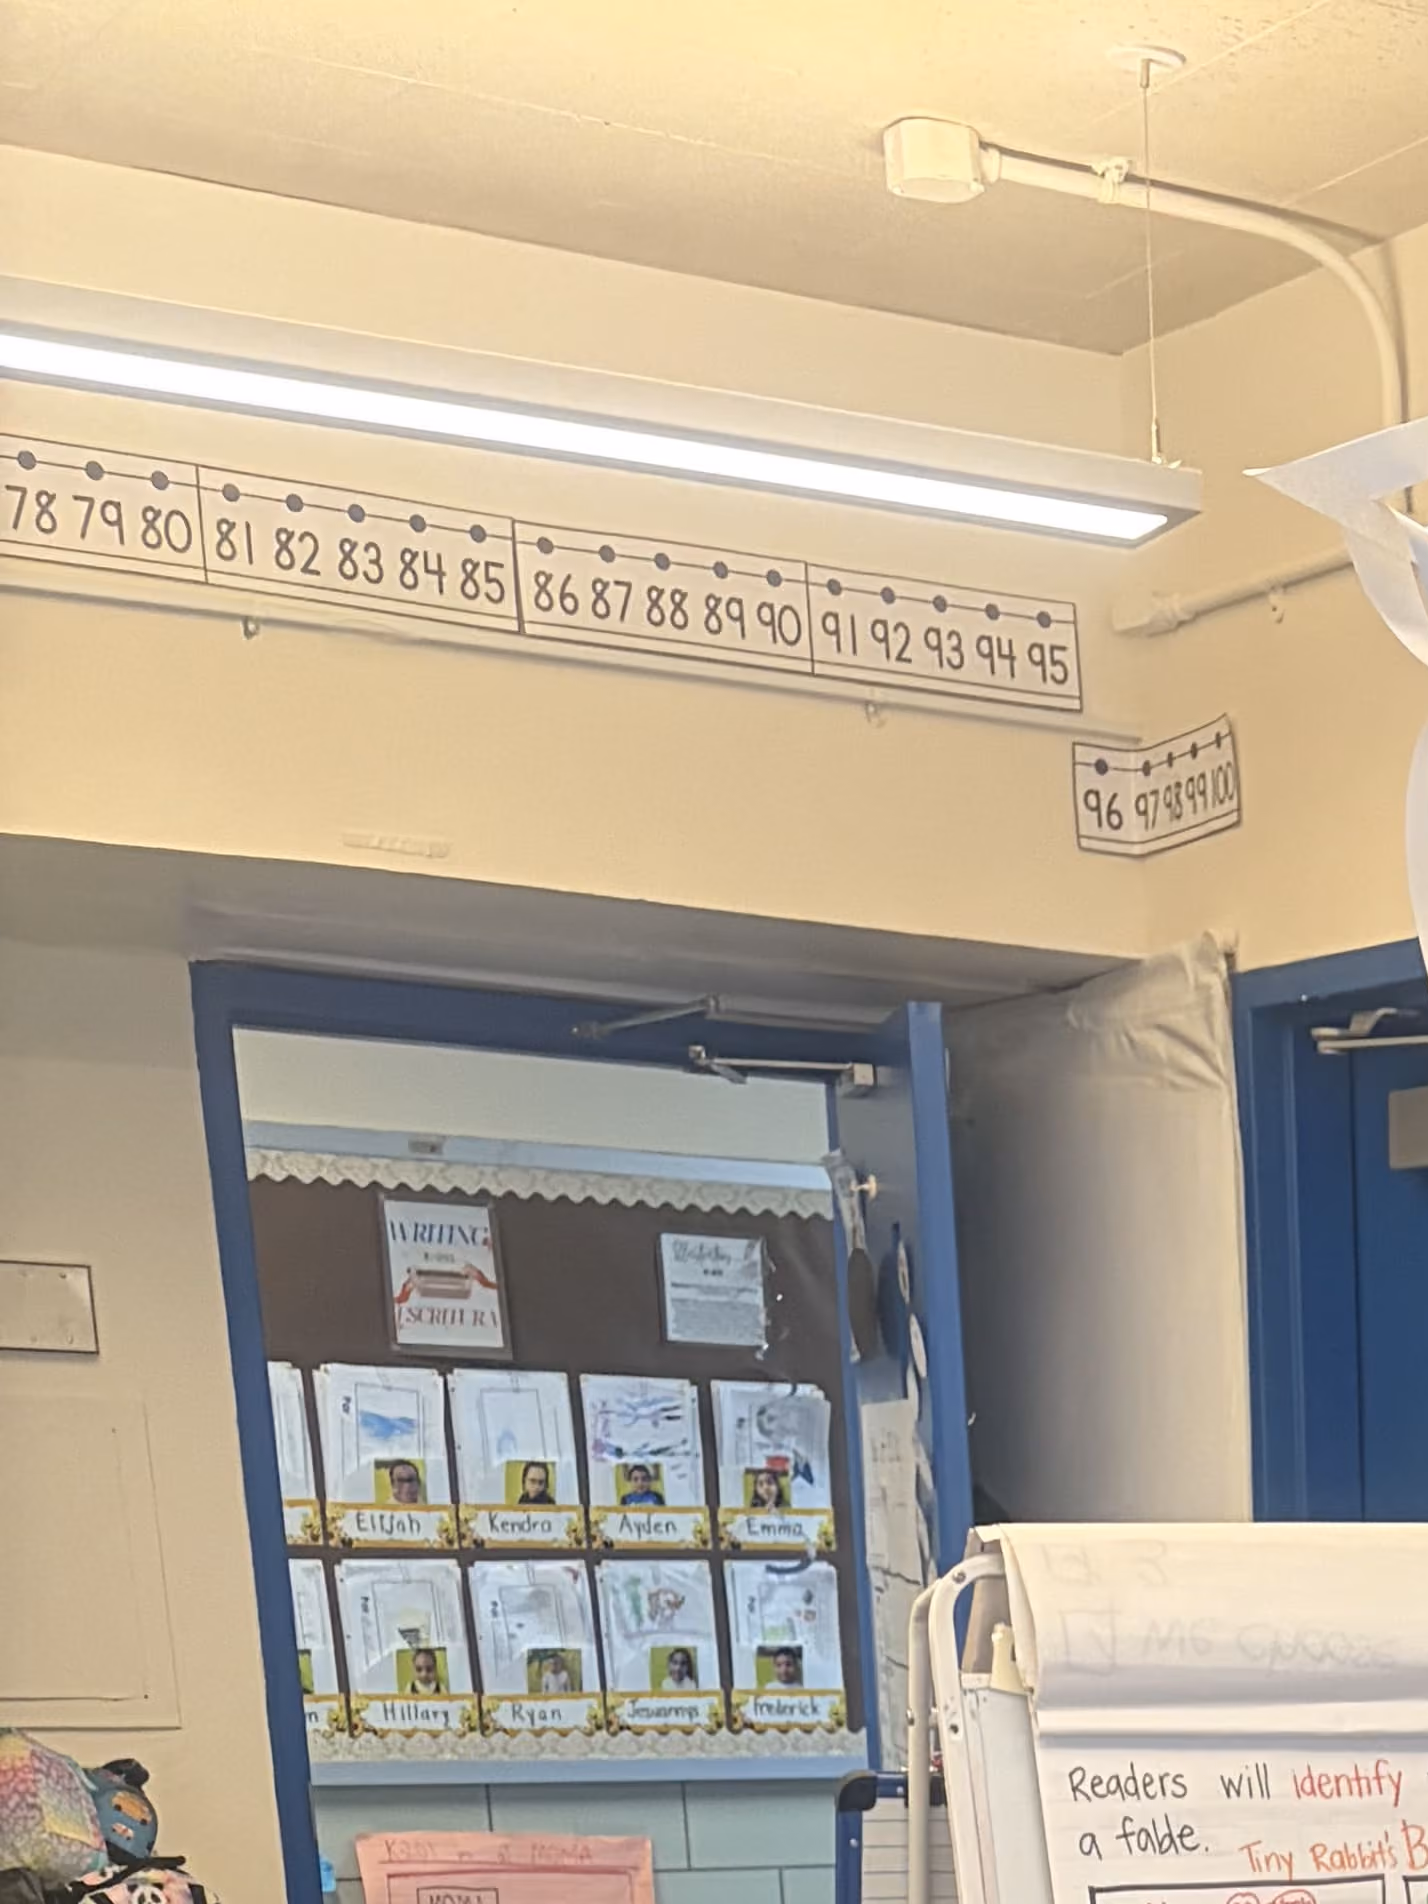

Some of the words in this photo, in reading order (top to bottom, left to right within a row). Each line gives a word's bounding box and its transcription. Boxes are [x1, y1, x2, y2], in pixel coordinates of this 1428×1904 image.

[4, 485, 57, 534] 78
[73, 495, 125, 546] 79
[141, 504, 193, 554] 80
[215, 518, 254, 565] 81
[274, 526, 321, 576] 82
[337, 537, 384, 585] 83
[399, 547, 446, 595] 84
[460, 557, 505, 603] 85
[533, 570, 579, 617] 86
[591, 577, 632, 622] 87
[645, 585, 689, 630] 88
[704, 593, 746, 641] 89
[757, 601, 802, 646] 90
[821, 614, 857, 656] 91
[870, 620, 913, 664] 92
[923, 627, 965, 671] 93
[975, 634, 1016, 678] 94
[1027, 642, 1069, 686] 95
[1082, 789, 1124, 831] 96
[1134, 786, 1161, 829] 97
[1162, 780, 1183, 823] 98
[1185, 774, 1207, 818] 99
[1208, 767, 1235, 809] 100
[489, 1512, 552, 1533] Kendra
[619, 1513, 677, 1540] Ayden
[747, 1516, 805, 1537] Emma
[512, 1703, 561, 1726] Ryan
[1069, 1761, 1188, 1802] Readers
[1220, 1762, 1270, 1799] will
[1079, 1832, 1102, 1860] a
[1240, 1840, 1292, 1880] Tiny
[1311, 1830, 1398, 1872] Rabbit's
